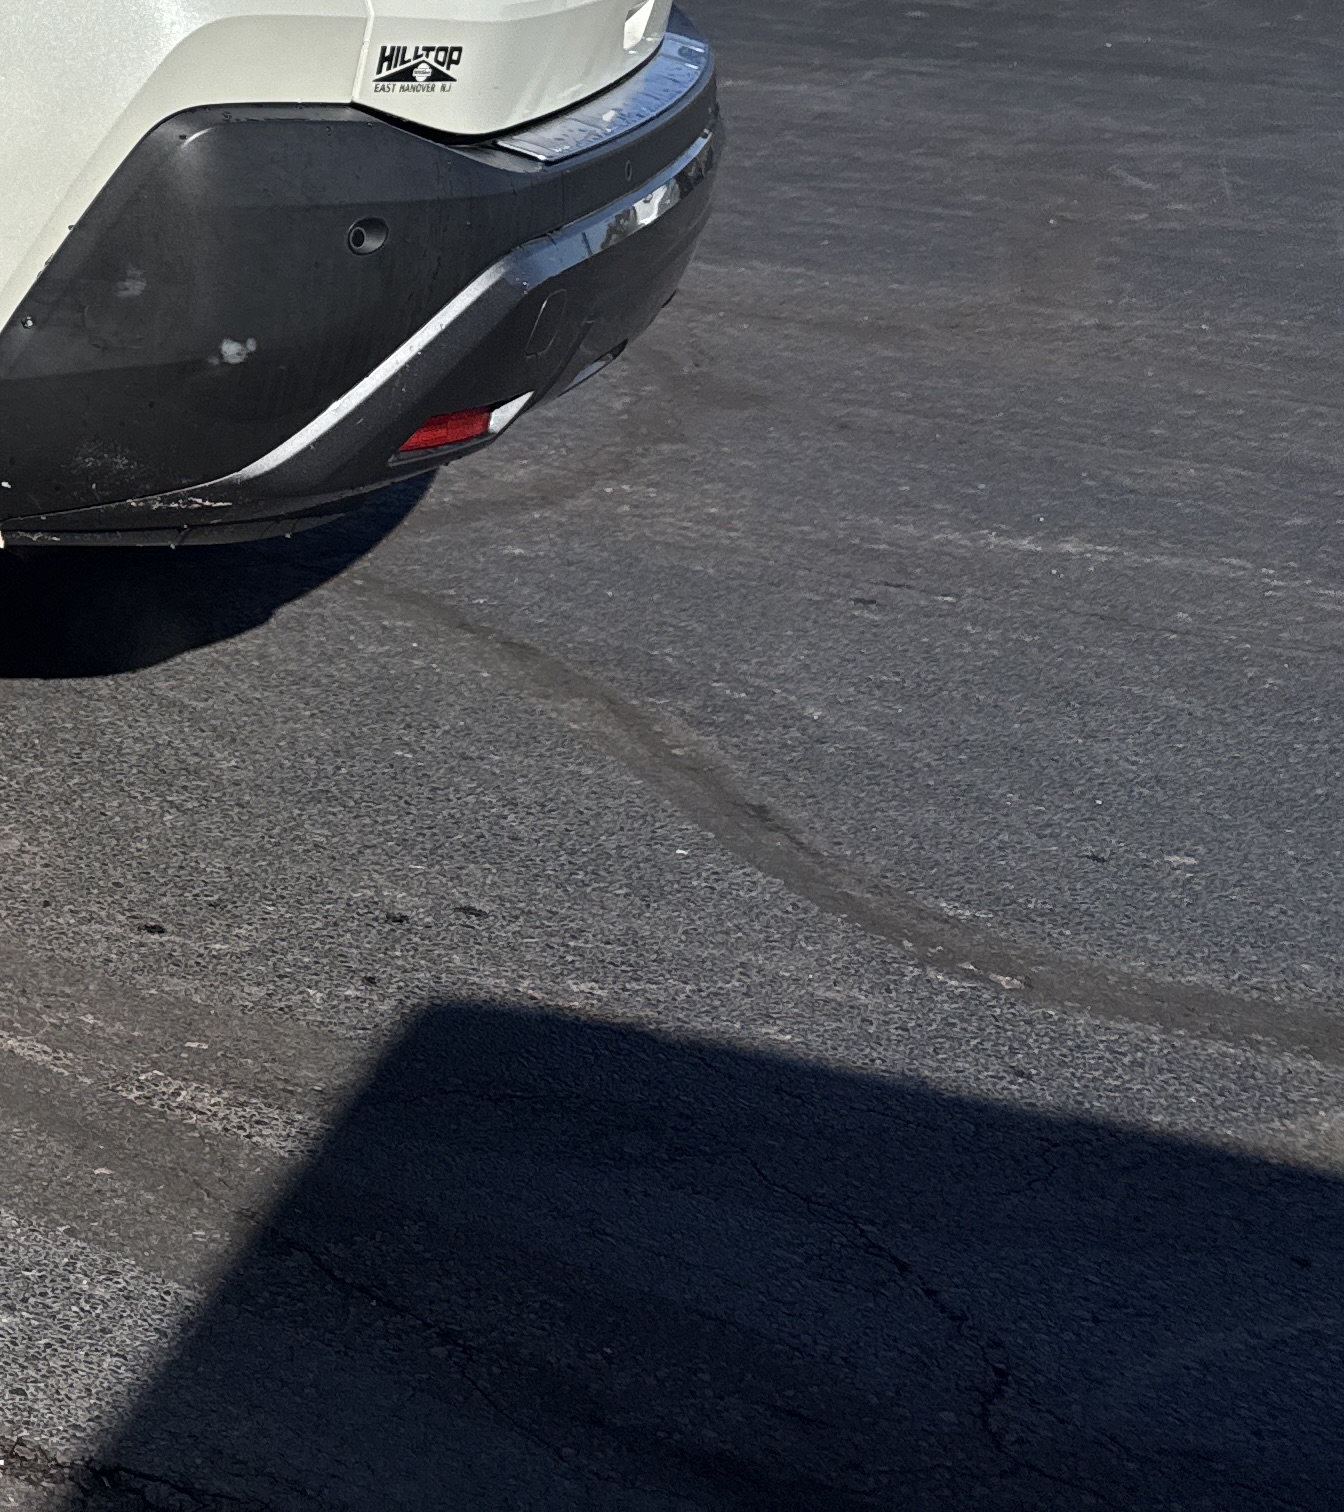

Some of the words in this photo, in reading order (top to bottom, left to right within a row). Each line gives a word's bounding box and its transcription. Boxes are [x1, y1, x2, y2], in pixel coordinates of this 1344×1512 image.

[375, 45, 463, 76] HILLTOP
[374, 83, 397, 93] EAST
[398, 83, 436, 93] HANOVER
